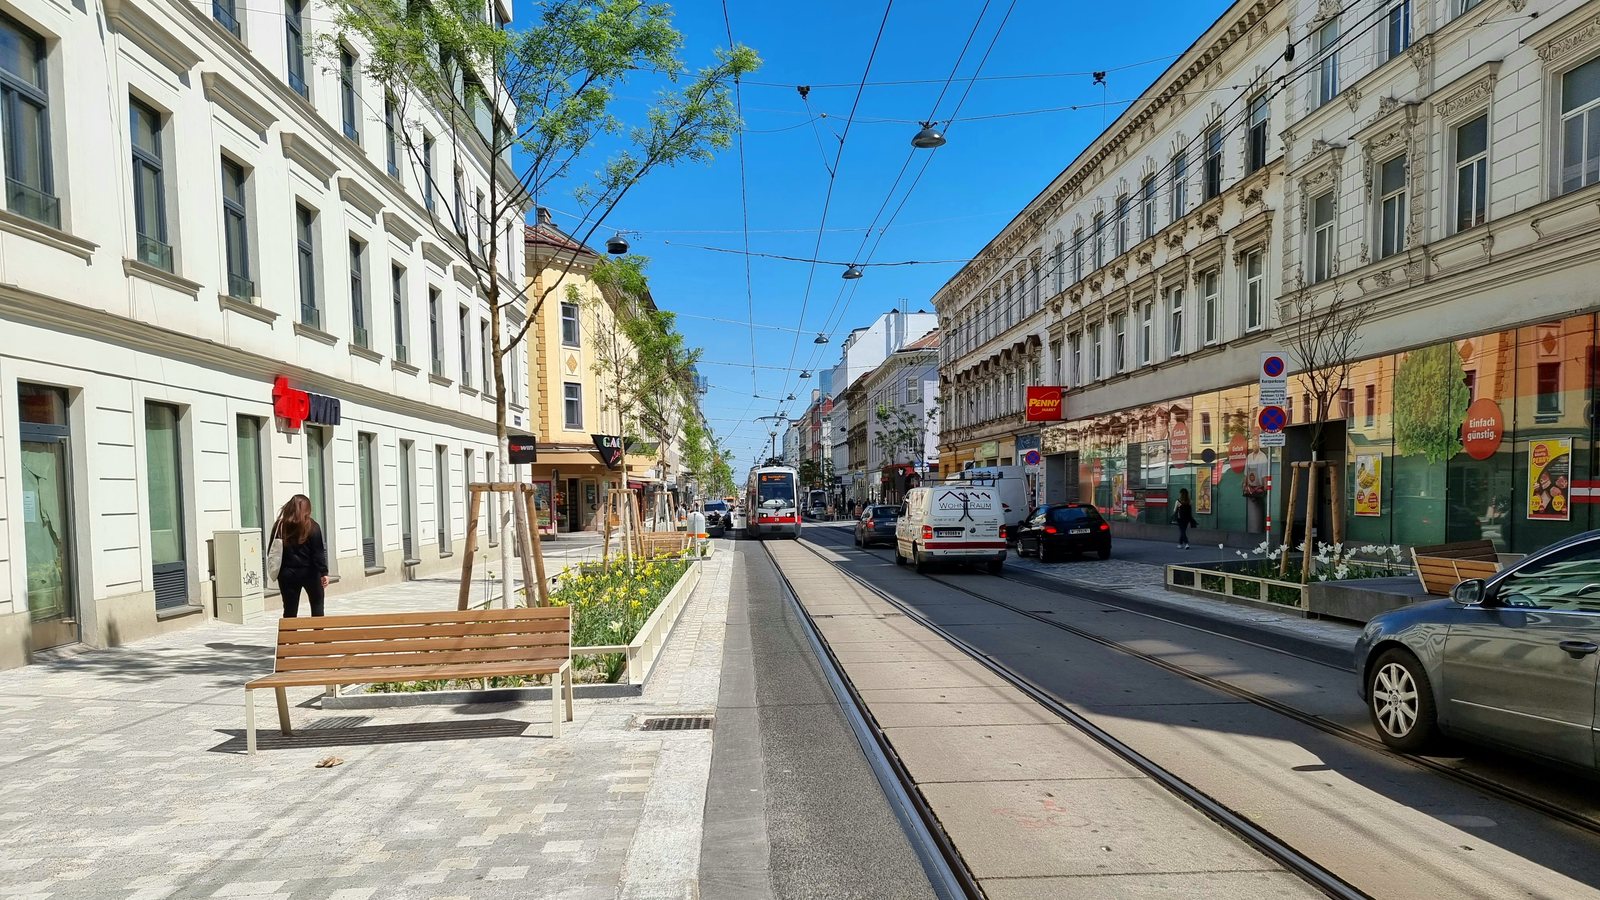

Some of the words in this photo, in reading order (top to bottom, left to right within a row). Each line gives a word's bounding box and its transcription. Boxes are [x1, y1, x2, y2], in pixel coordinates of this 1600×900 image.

[1028, 398, 1061, 407] PENNY
[1469, 417, 1496, 428] Einfach
[1467, 429, 1497, 442] günstig.
